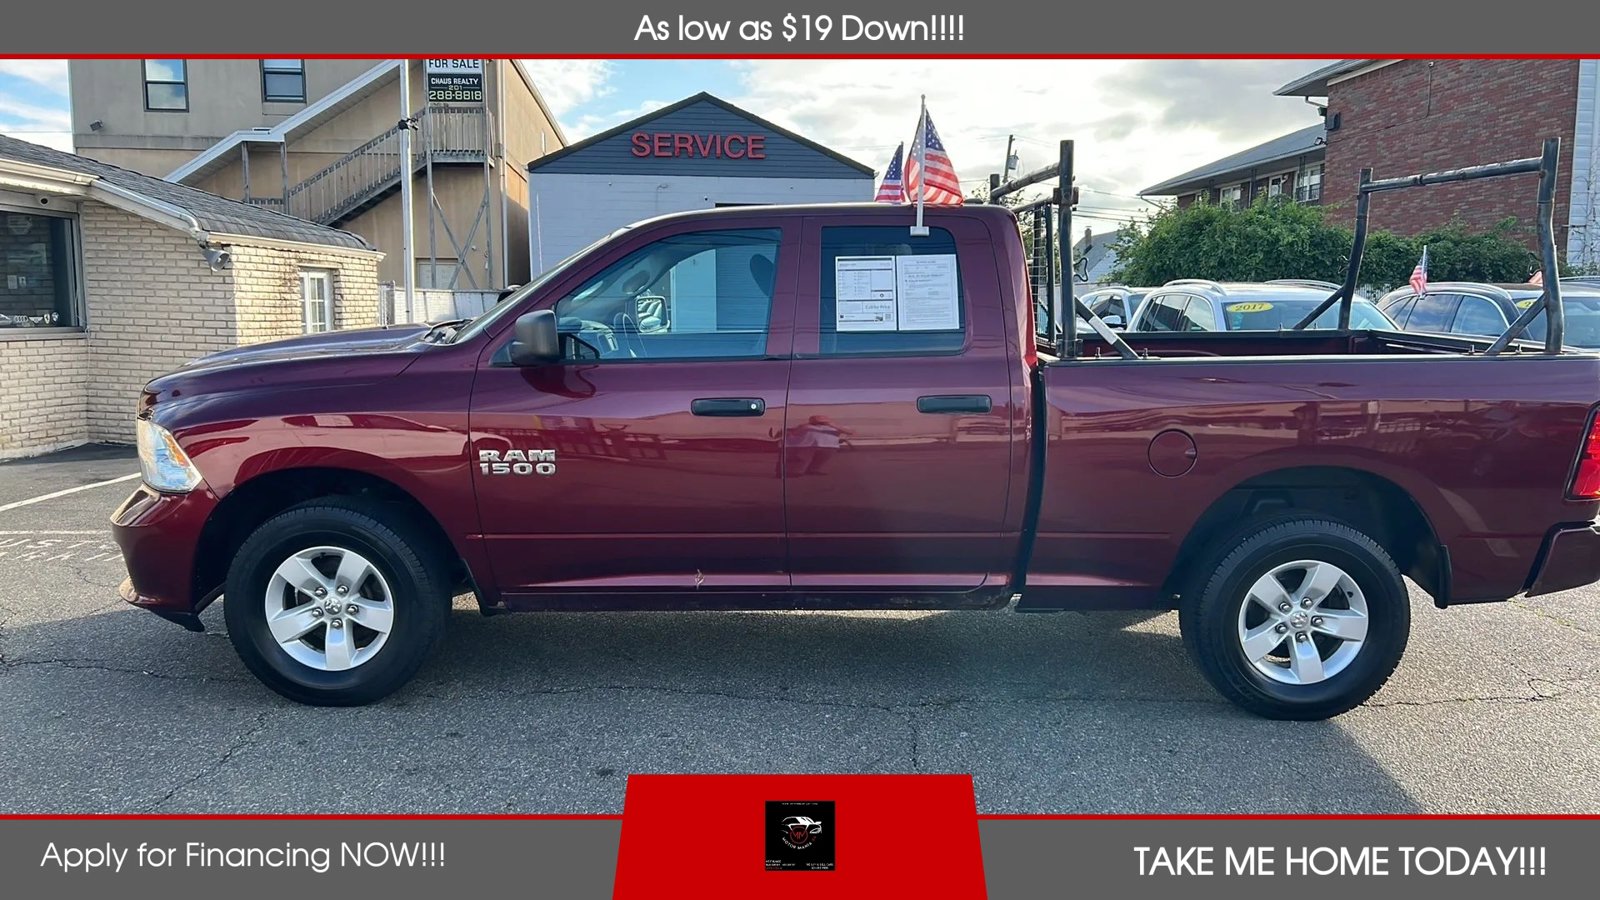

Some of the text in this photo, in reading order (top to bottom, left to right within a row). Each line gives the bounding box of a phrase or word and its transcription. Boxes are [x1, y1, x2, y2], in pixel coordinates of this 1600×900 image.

[429, 59, 480, 68] FOR SALE
[631, 132, 766, 159] SERVICE
[1235, 303, 1264, 311] 2017
[479, 449, 556, 462] RAM
[480, 462, 556, 475] 1500
